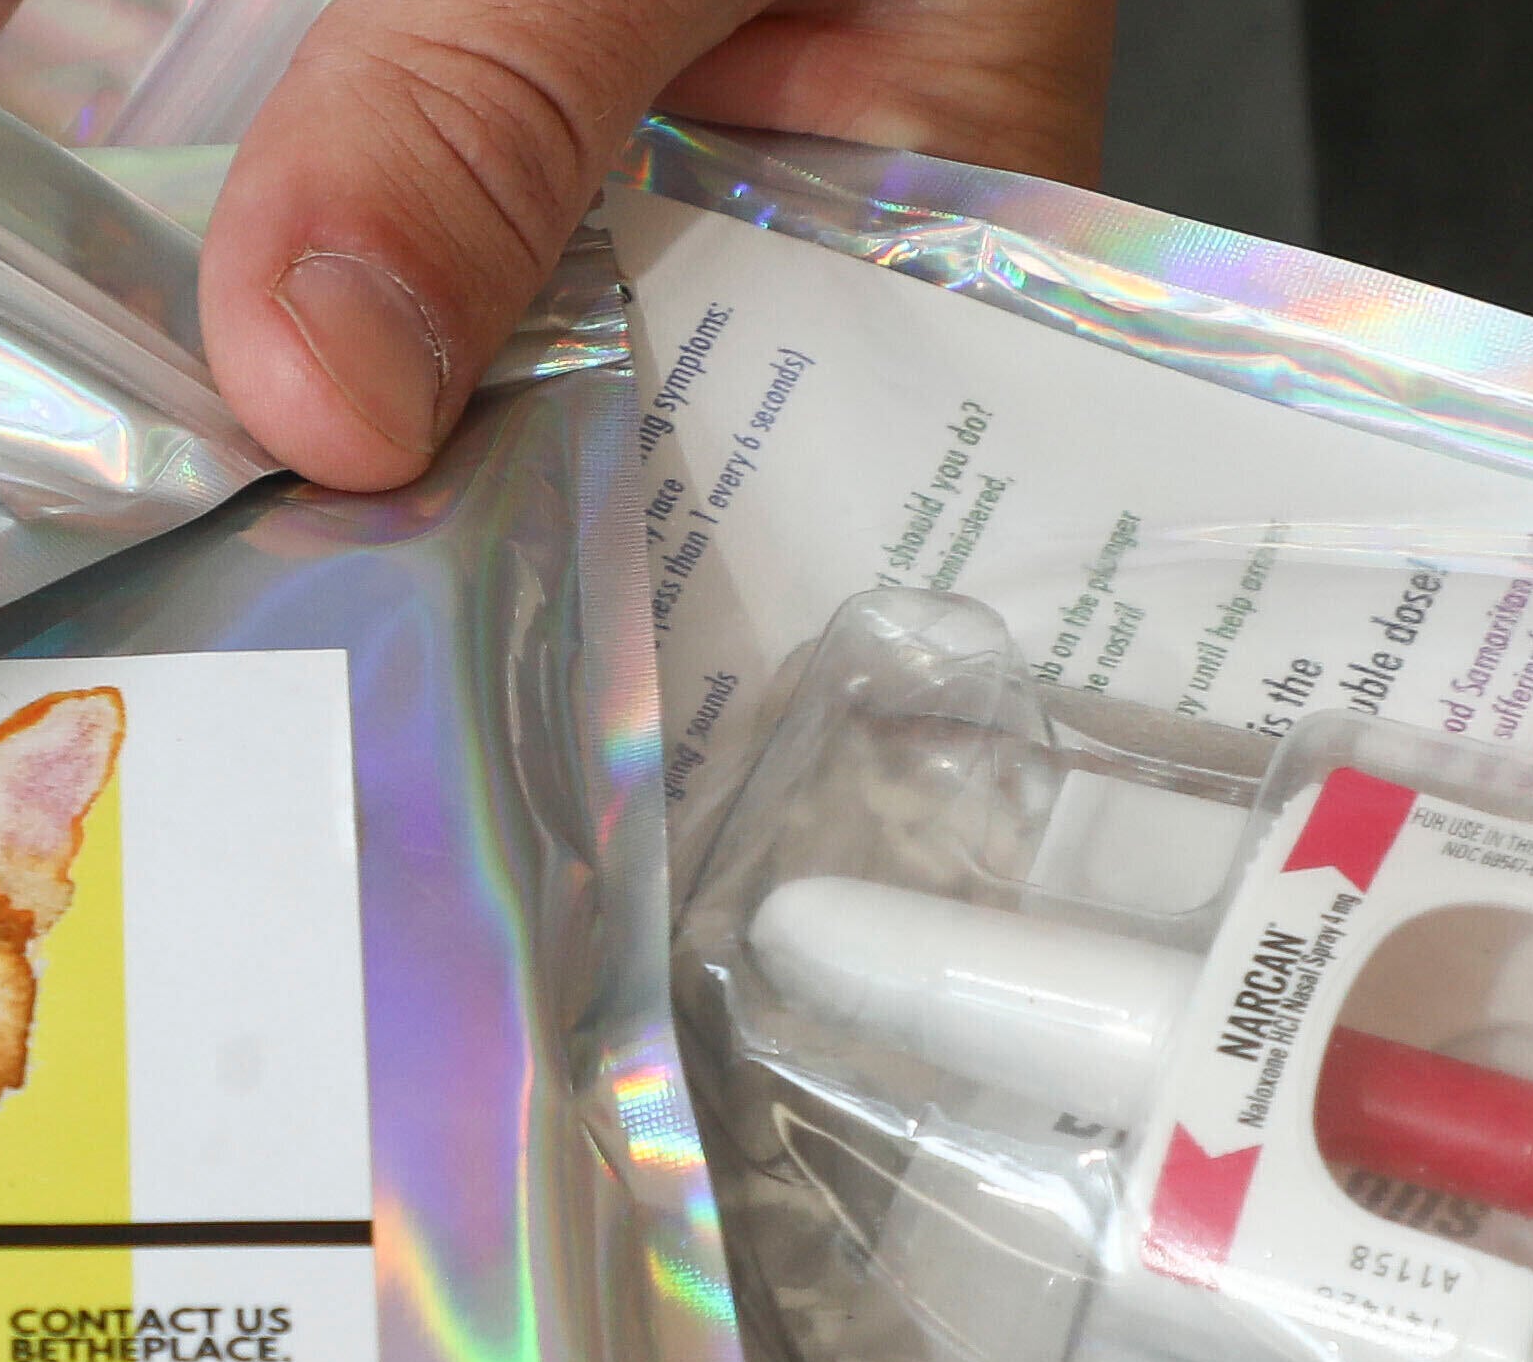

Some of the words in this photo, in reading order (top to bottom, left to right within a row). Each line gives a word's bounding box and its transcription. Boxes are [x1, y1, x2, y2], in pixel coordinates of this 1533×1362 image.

[653, 301, 734, 413] symptoms:
[750, 347, 816, 433] seconds)
[732, 433, 761, 450] 6
[947, 398, 994, 447] do?
[709, 451, 758, 510] every
[931, 449, 968, 495] you
[689, 509, 719, 524] 1
[881, 491, 945, 571] should
[662, 529, 710, 579] than
[1097, 600, 1146, 669] nostril
[1204, 596, 1257, 640] help
[1051, 631, 1081, 659] on
[1189, 641, 1228, 691] until
[687, 671, 738, 741] sounds
[1262, 658, 1324, 707] the
[1412, 806, 1446, 831] FOR
[1448, 817, 1484, 842] USE
[1483, 828, 1505, 847] IN
[1331, 893, 1364, 916] mg
[1300, 925, 1348, 968] Spray
[1280, 966, 1322, 1014] Nasal
[1237, 1047, 1289, 1129] Naloxone
[1348, 1245, 1461, 1295] A1158
[10, 1307, 223, 1333] CONTACT
[236, 1307, 292, 1333] US
[11, 1336, 292, 1362] BETHEPLACE.
